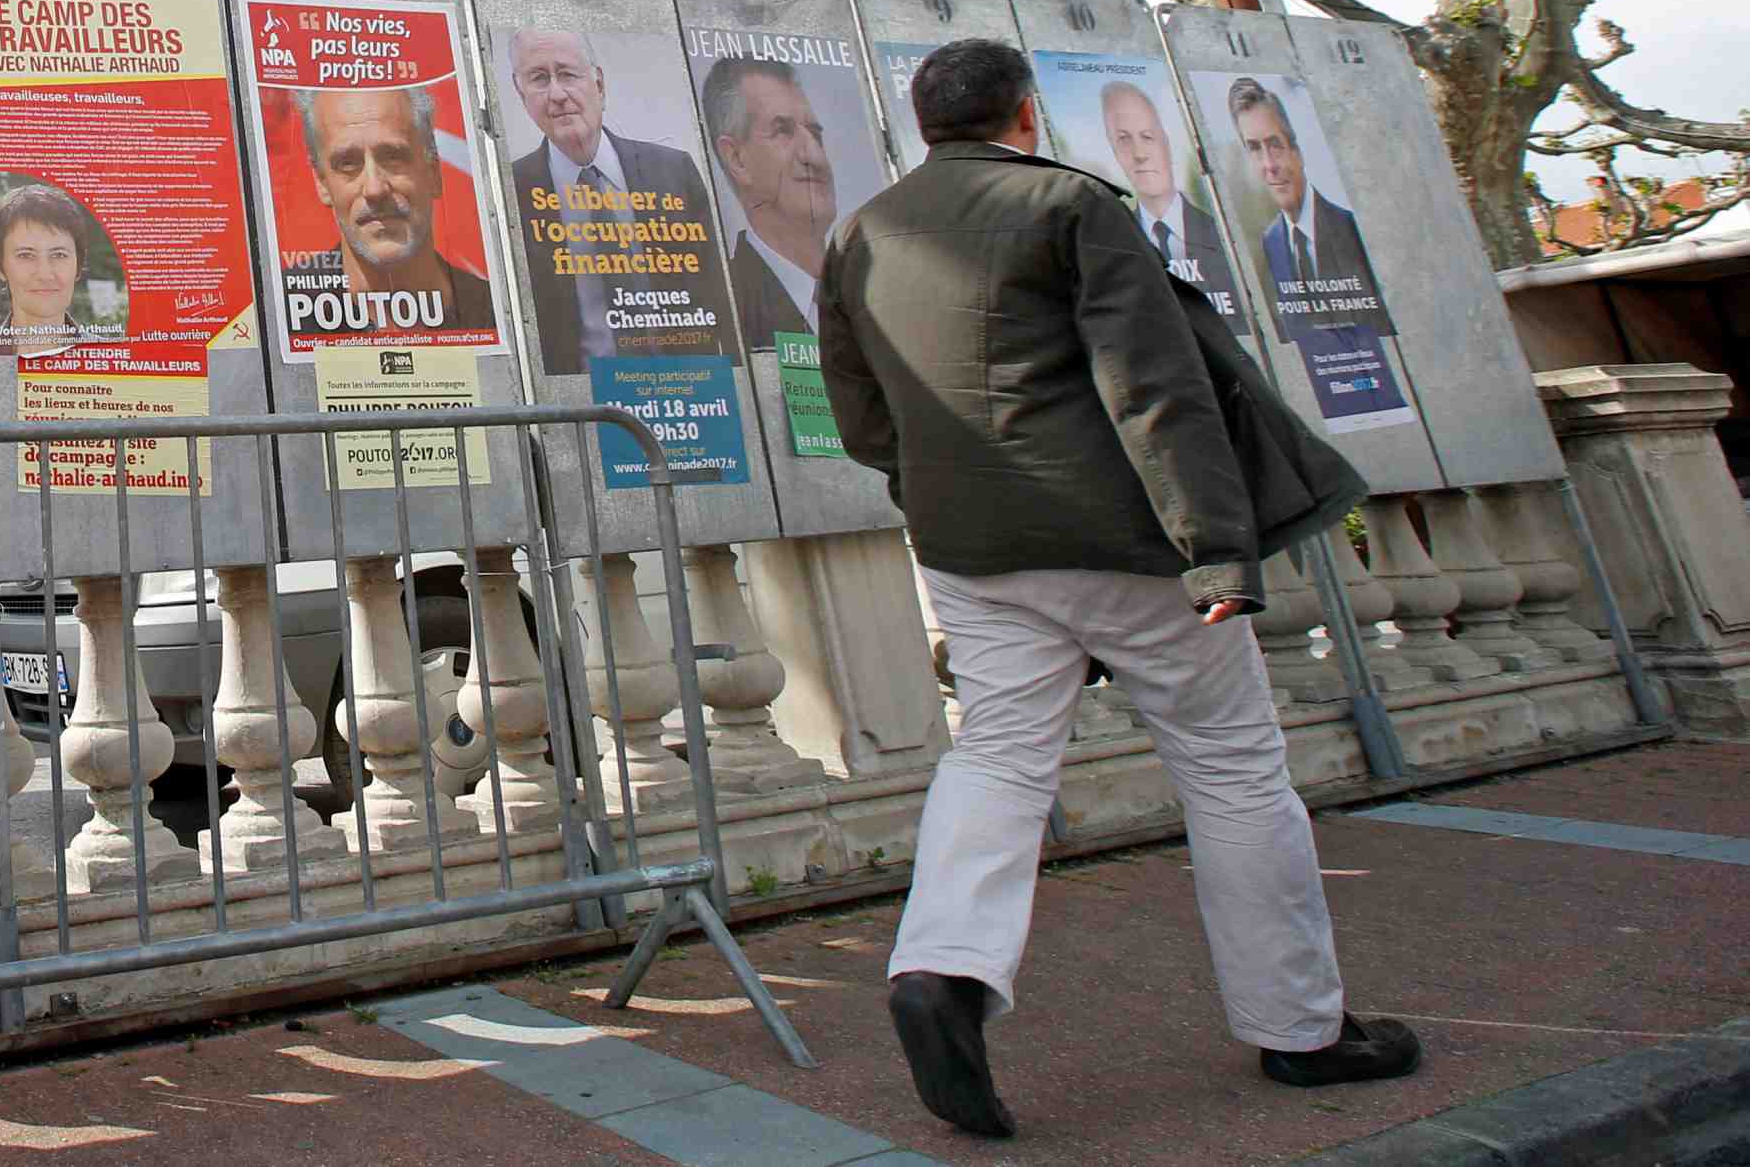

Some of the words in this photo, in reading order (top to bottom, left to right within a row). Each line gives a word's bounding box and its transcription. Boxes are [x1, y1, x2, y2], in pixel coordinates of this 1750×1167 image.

[17, 0, 95, 26] CAMP
[101, 2, 152, 27] DES
[1067, 1, 1096, 32] 10
[326, 11, 362, 33] Nos
[366, 14, 411, 38] vies,
[311, 37, 347, 59] pas
[351, 35, 400, 57] leurs
[689, 28, 743, 59] JEAN
[750, 34, 853, 67] LASSALLE
[1225, 32, 1250, 58] 11
[1336, 39, 1365, 64] 12
[29, 56, 104, 73] NATHALIE
[109, 56, 180, 73] ARTHAUD
[261, 48, 297, 67] NPA
[888, 55, 905, 71] LA
[74, 91, 145, 106] travailleurs,
[531, 188, 561, 210] Se
[566, 184, 656, 210] libérer
[662, 193, 683, 211] de
[530, 217, 707, 248] l'occupation
[282, 250, 343, 270] VOTEZ
[553, 247, 699, 275] financière
[1164, 259, 1205, 282] OIX
[286, 274, 350, 290] PHILIPPE
[1278, 281, 1306, 294] UNE
[1306, 275, 1362, 293] VOLONTÉ
[613, 287, 690, 308] Jacques
[1276, 300, 1311, 314] POUR
[1312, 300, 1329, 312] LA
[1330, 296, 1378, 312] FRANCE
[287, 290, 445, 332] POUTOU
[606, 308, 716, 330] Cheminade
[29, 325, 76, 335] Nathalie
[142, 331, 168, 341] Lutte
[169, 329, 211, 341] ouvrière
[293, 337, 327, 348] Ouvrier
[335, 335, 372, 346] candidat
[374, 335, 433, 347] anticapitaliste
[65, 349, 130, 360] ENTENDRE
[393, 355, 411, 366] NPA
[781, 343, 821, 365] JEAN
[25, 361, 41, 371] LE
[45, 361, 81, 371] CAMP
[85, 361, 110, 371] DES
[114, 361, 200, 372] TRAVAILLEURS
[327, 381, 350, 390] Toutes
[352, 381, 363, 390] les
[364, 380, 410, 390] informations
[431, 381, 466, 391] campagne
[614, 371, 656, 384] Meeting
[24, 382, 52, 394] Pour
[635, 386, 650, 395] sur
[24, 397, 42, 409] les
[45, 397, 75, 410] lieux
[78, 400, 90, 410] et
[93, 400, 134, 412] heures
[136, 401, 151, 412] de
[153, 403, 174, 413] nos
[663, 399, 685, 418] 18
[689, 399, 729, 417] avril
[51, 452, 137, 467] campage
[3, 656, 49, 684] BK-728-S
